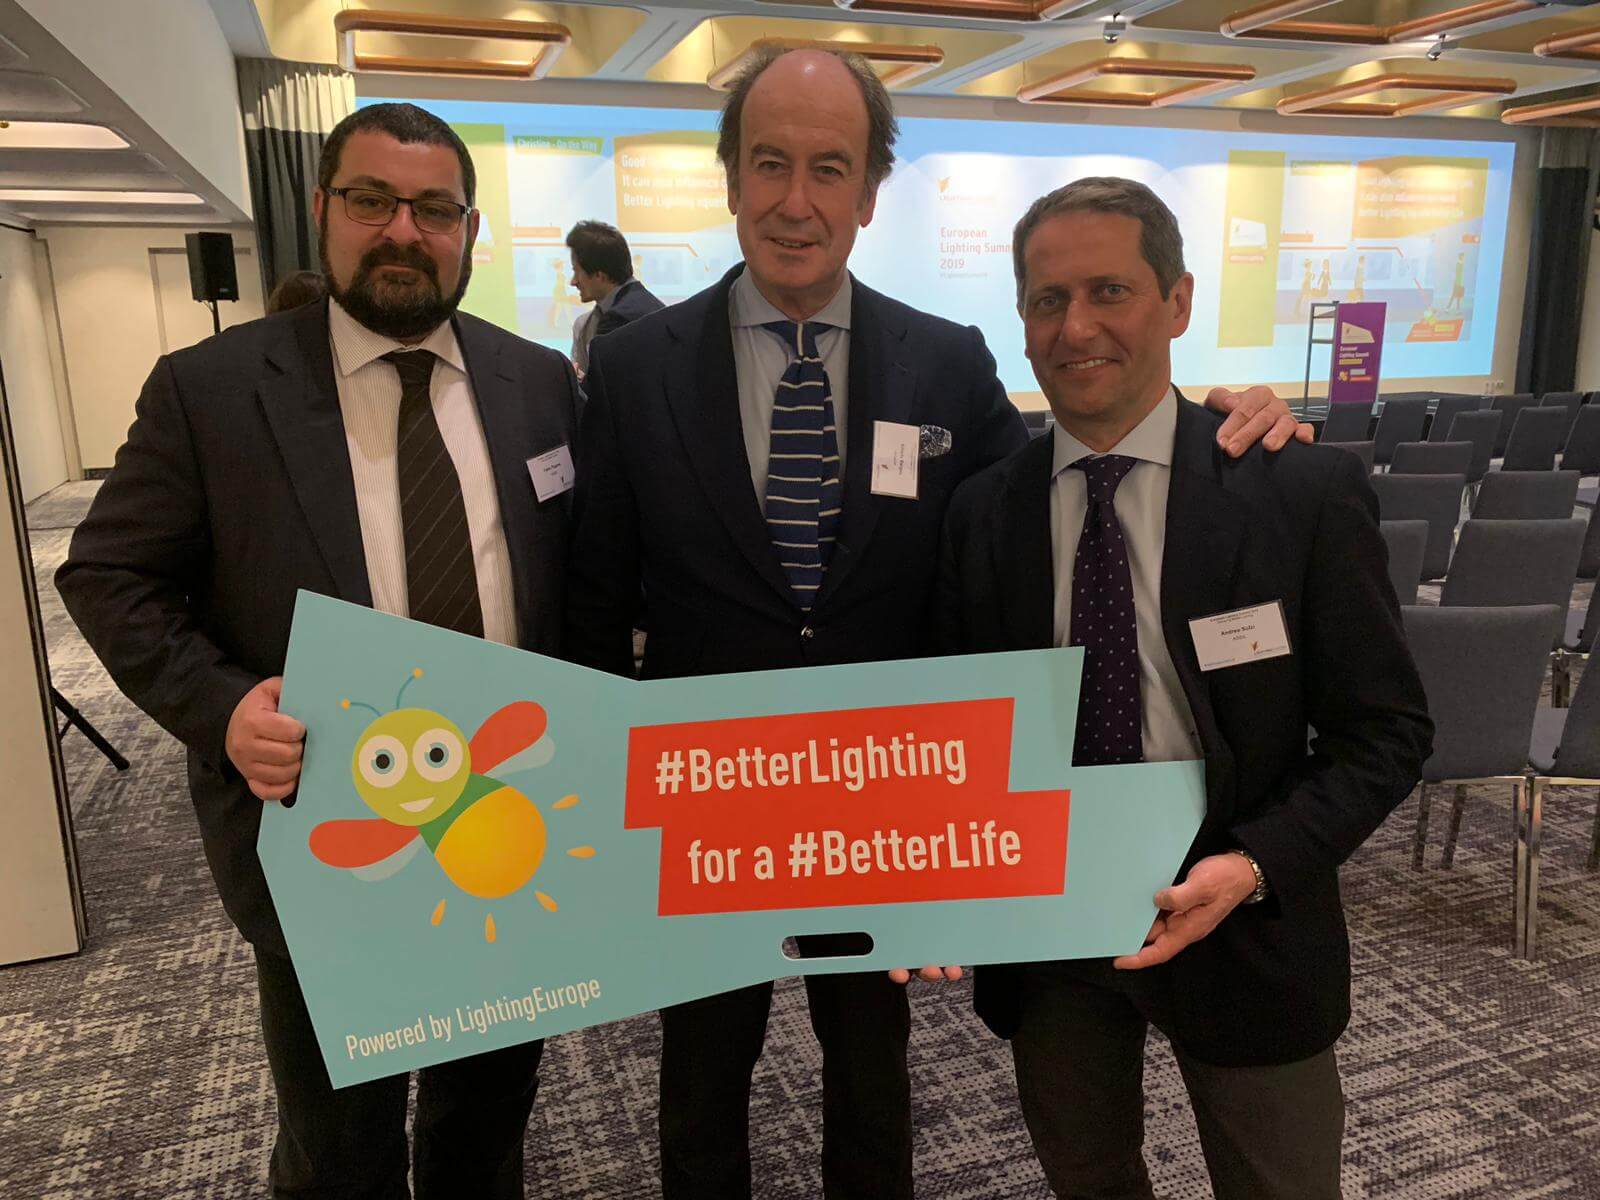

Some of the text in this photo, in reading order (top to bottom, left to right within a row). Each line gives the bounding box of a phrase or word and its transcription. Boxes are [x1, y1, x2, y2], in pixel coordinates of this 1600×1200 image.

[622, 155, 646, 169] Good
[623, 192, 652, 208] Better
[940, 227, 988, 239] European
[940, 241, 982, 255] Lighting
[940, 258, 965, 270] 2019
[655, 732, 968, 795] #BetterLighting
[687, 820, 1022, 884] for a #BetterLife
[345, 979, 602, 1060] Powered by LightingEurope
